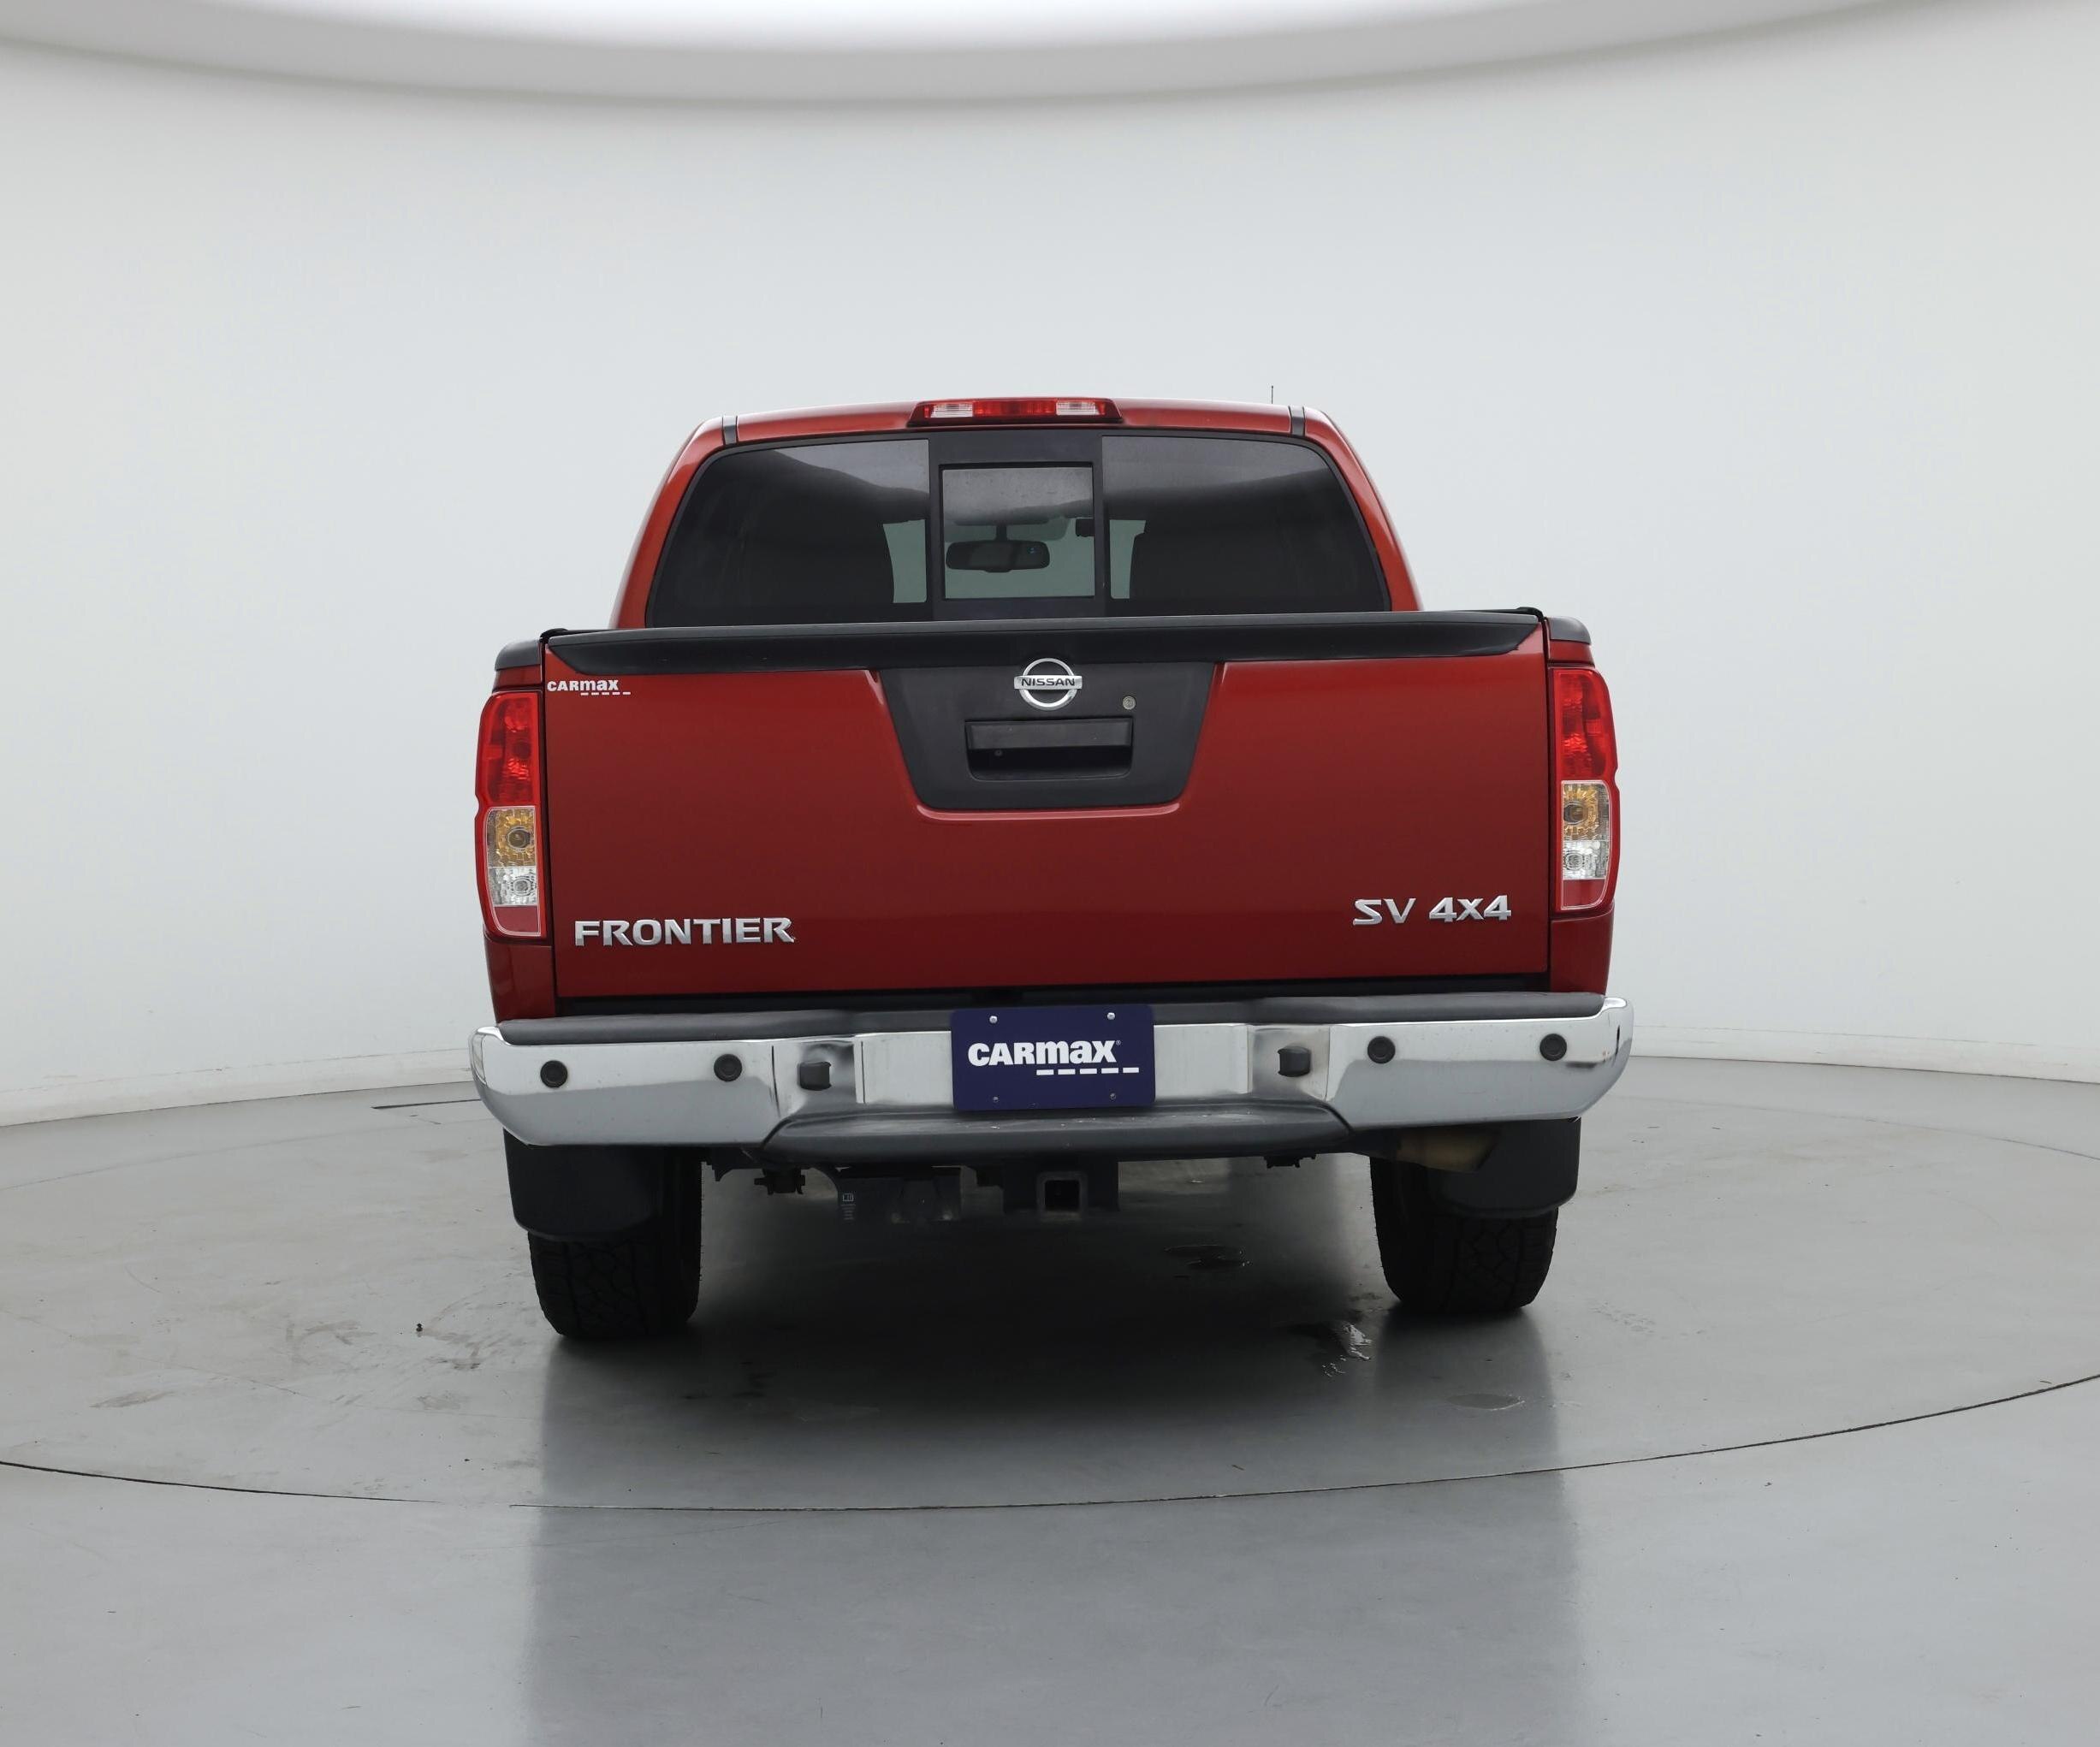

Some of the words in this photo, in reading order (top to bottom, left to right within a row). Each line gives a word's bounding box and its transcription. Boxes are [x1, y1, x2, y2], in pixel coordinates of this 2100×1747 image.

[1021, 678, 1076, 686] NISSAN
[1352, 898, 1416, 926] SV
[574, 917, 795, 946] FRONTIER
